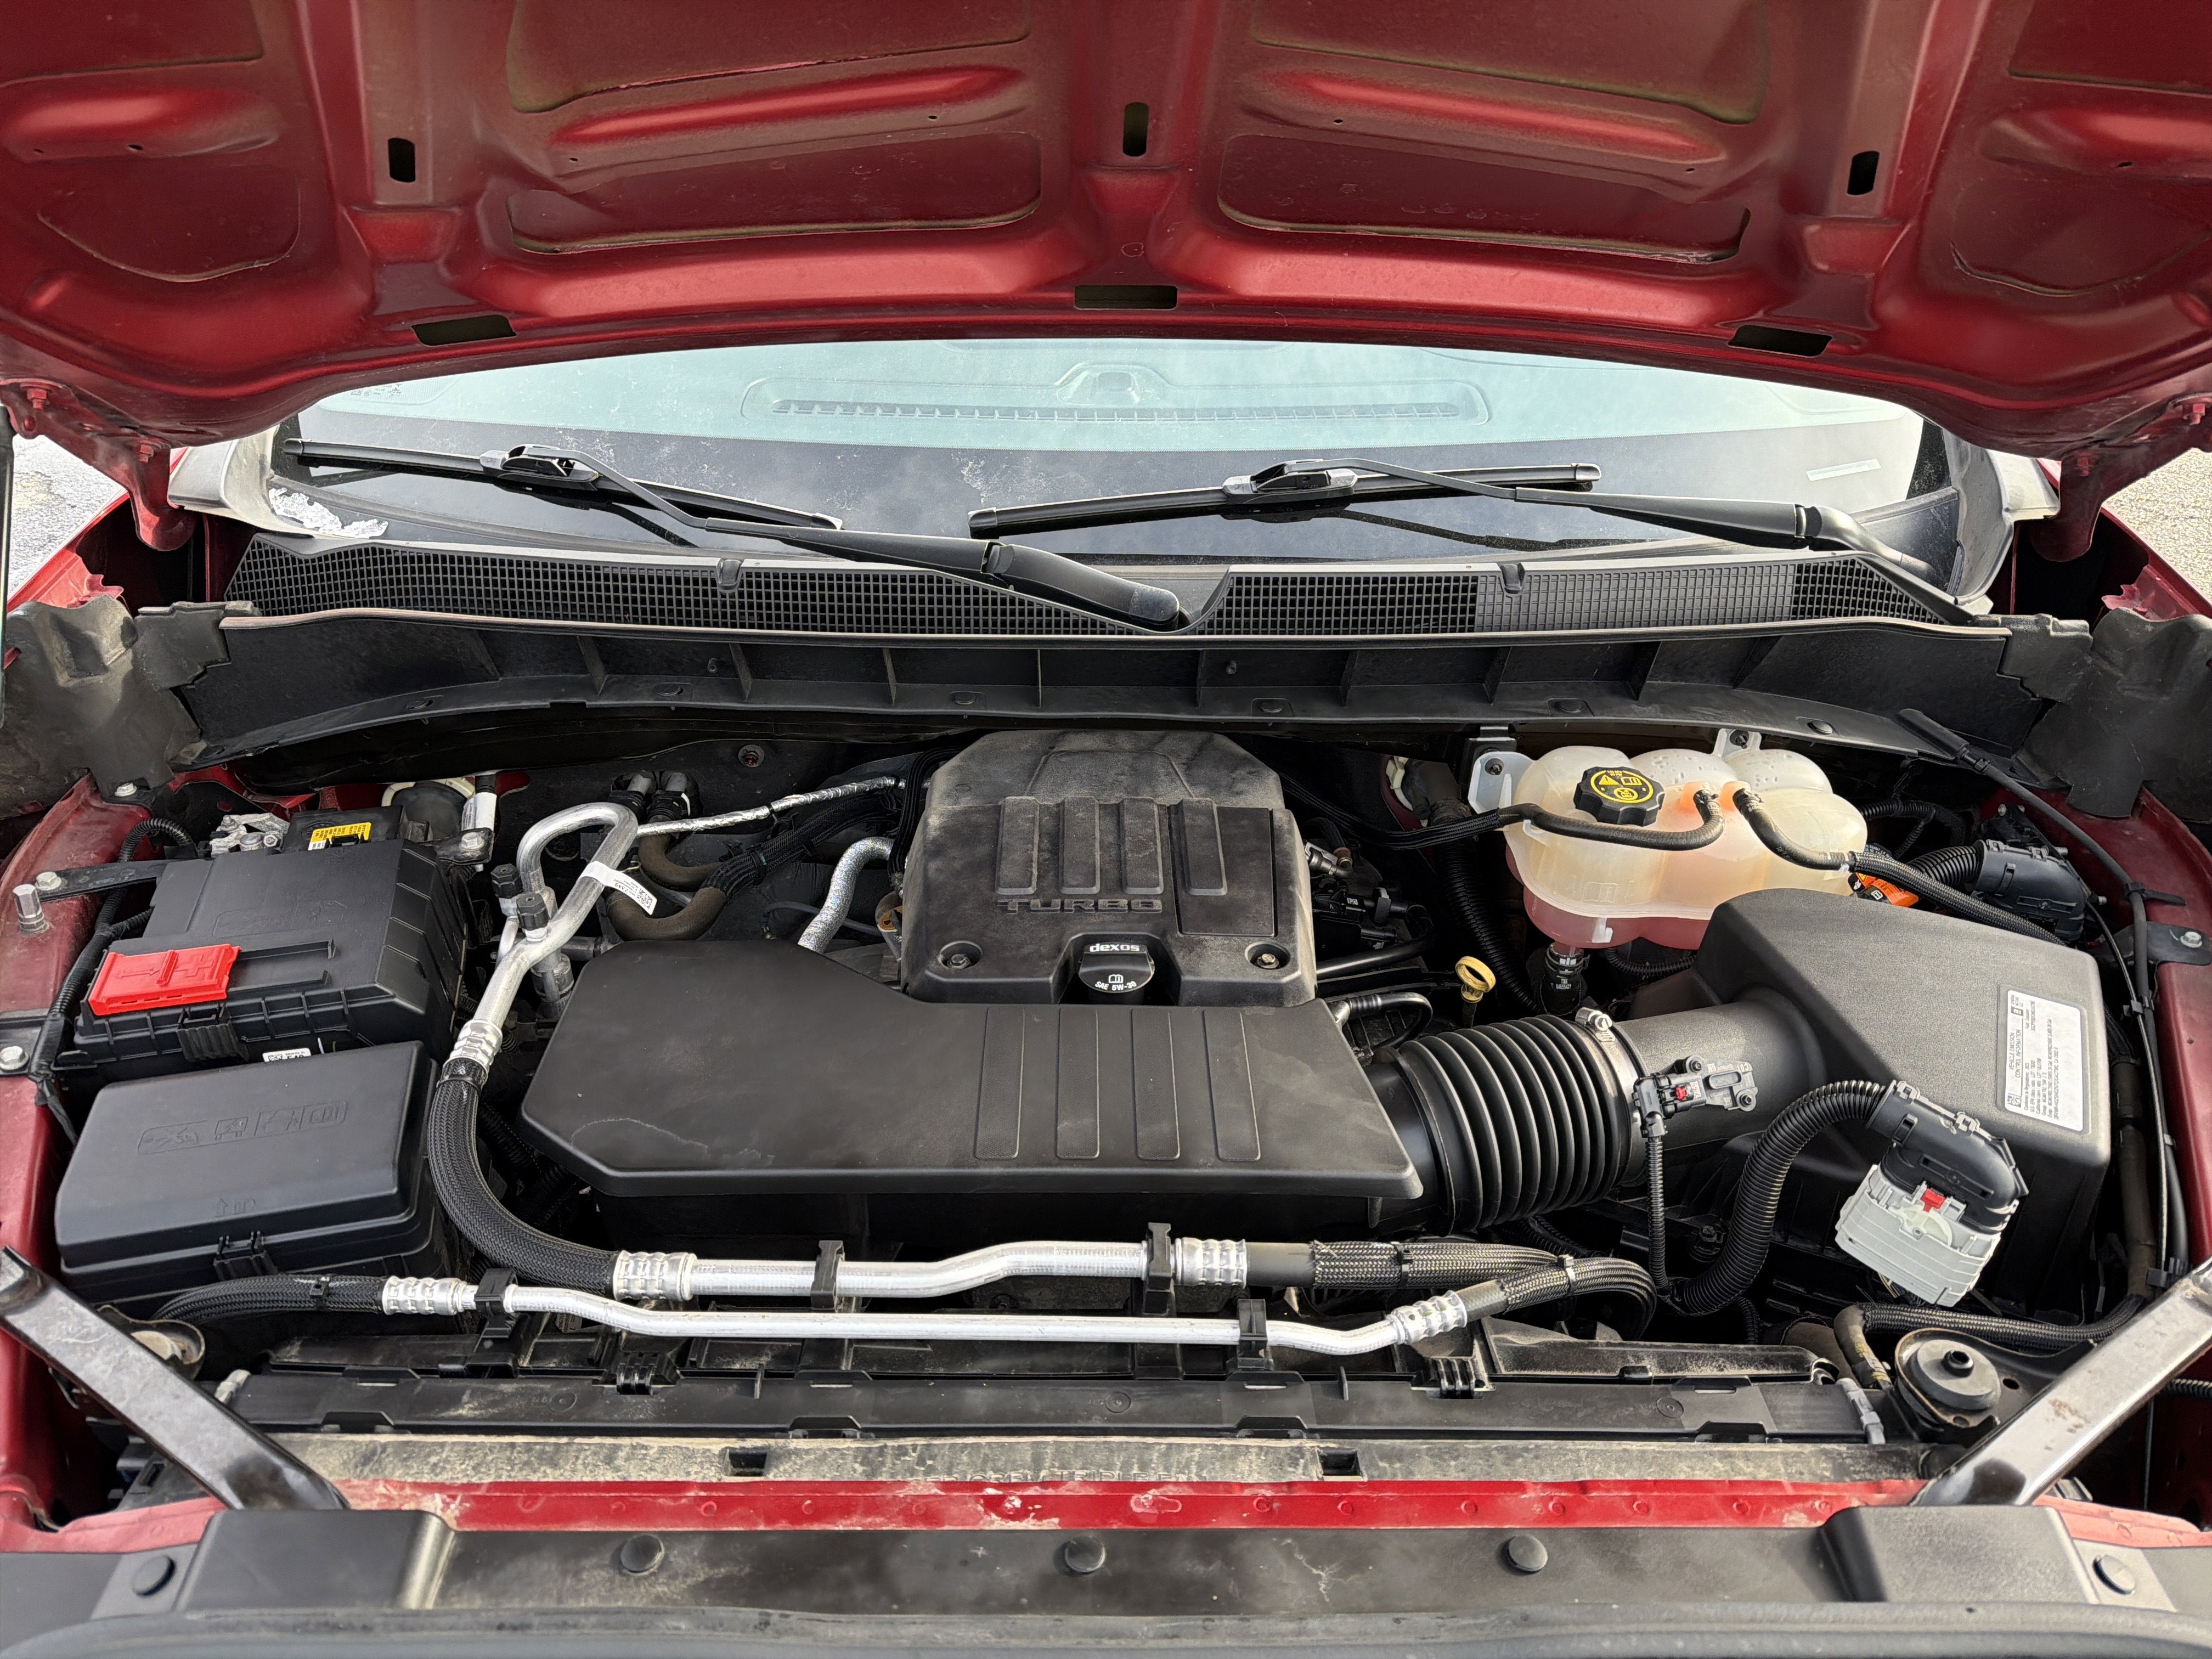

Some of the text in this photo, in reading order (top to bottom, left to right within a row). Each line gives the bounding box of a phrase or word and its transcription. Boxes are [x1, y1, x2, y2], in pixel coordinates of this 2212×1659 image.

[614, 882, 629, 893] 2349
[997, 899, 1163, 914] TURBO
[1090, 943, 1140, 952] dexos
[1095, 981, 1137, 991] SAE 5W-30
